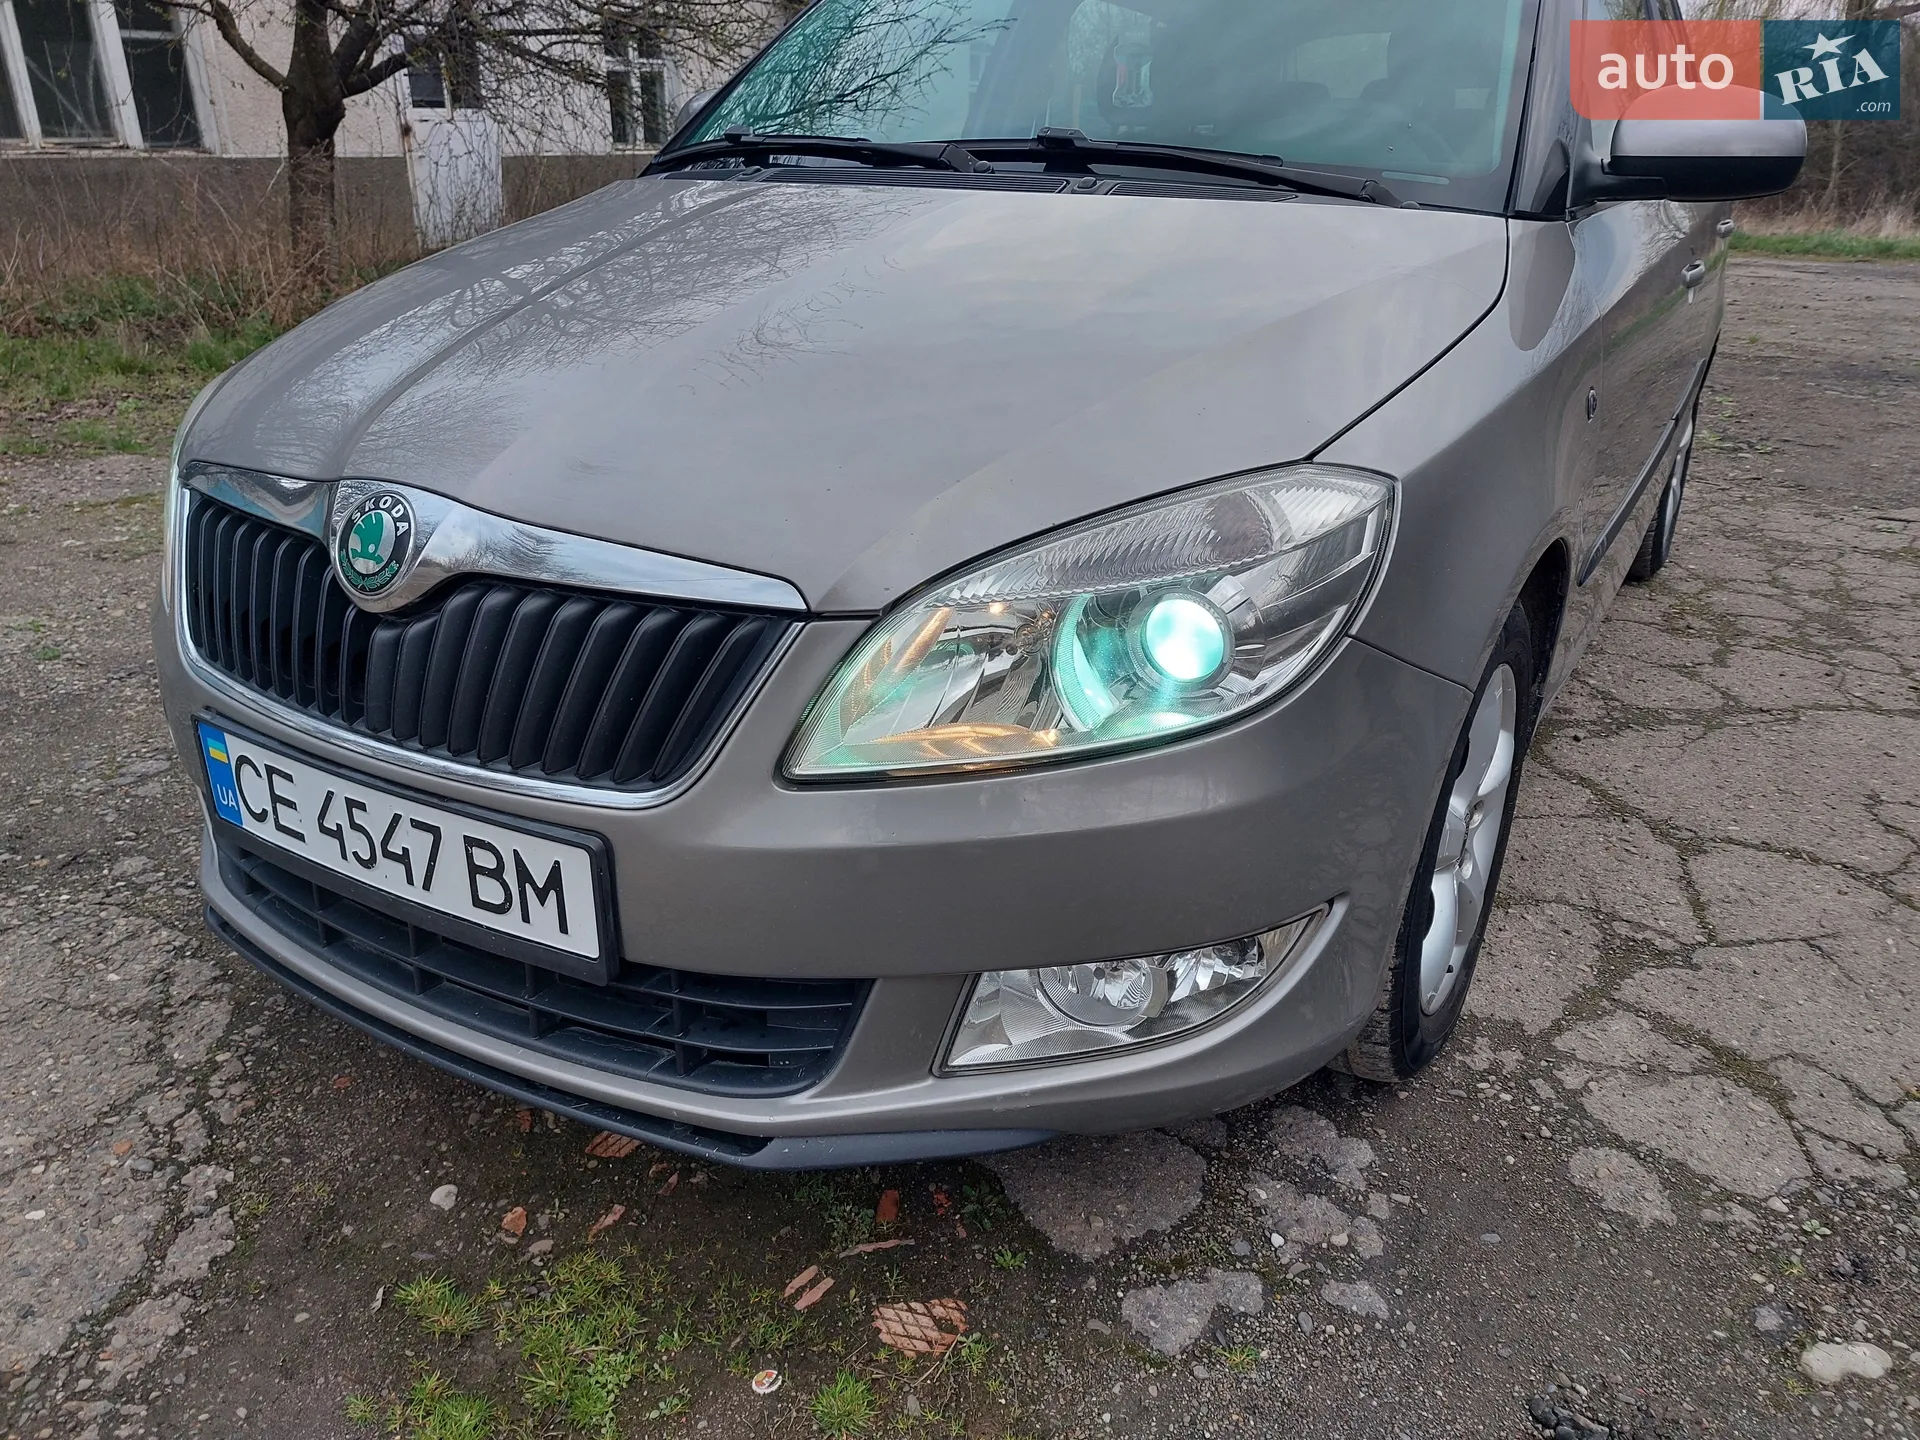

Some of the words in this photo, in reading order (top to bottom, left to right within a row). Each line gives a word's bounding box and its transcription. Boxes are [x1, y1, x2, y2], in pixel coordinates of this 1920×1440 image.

[217, 784, 238, 811] UA
[234, 755, 306, 843] CE
[317, 789, 442, 892] 4547
[463, 834, 569, 935] BM
